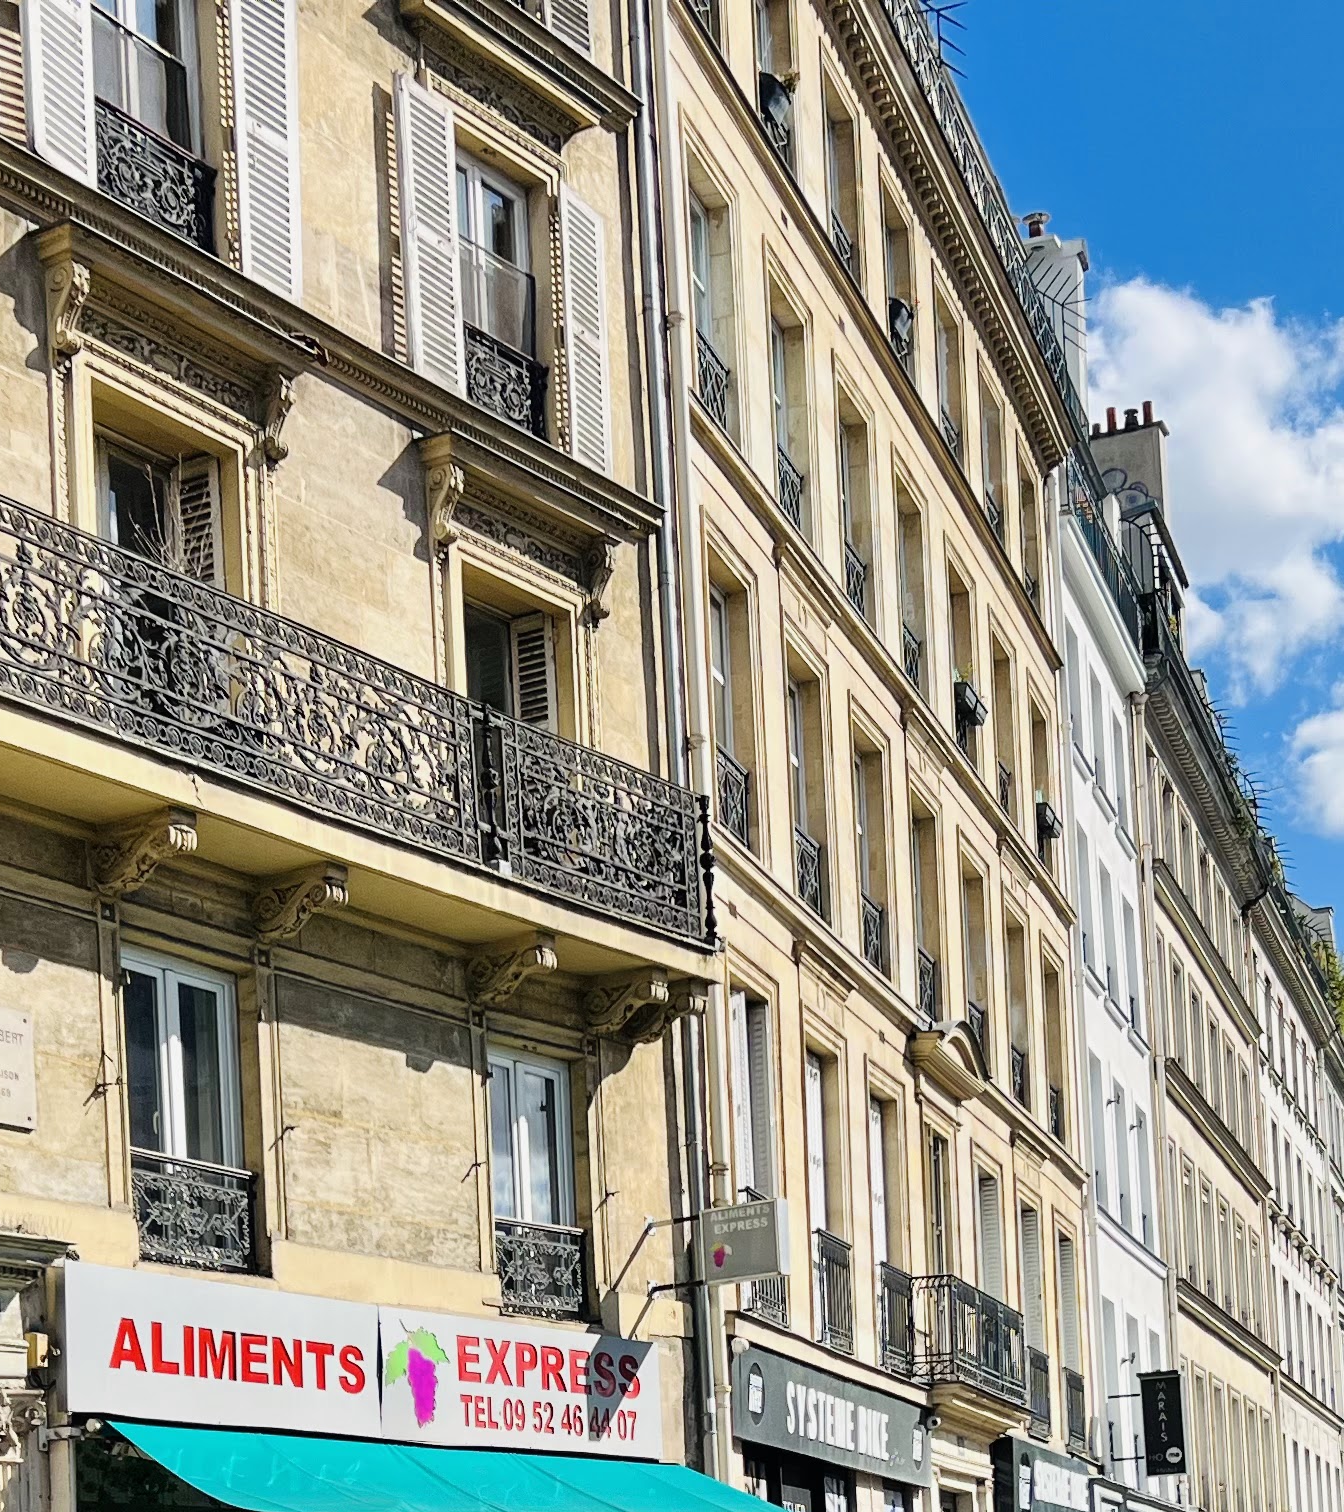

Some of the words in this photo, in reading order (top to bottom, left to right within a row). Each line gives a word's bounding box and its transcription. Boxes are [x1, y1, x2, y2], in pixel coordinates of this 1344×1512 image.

[709, 1203, 771, 1222] ALIMENTS
[713, 1216, 768, 1235] EXPRESS
[108, 1316, 366, 1395] ALIMENTS
[456, 1334, 641, 1400] EXPRESS
[532, 1400, 555, 1435] 52
[560, 1403, 584, 1437] 46
[589, 1406, 612, 1439] 44
[616, 1409, 637, 1441] 07
[1155, 1381, 1168, 1443] MARAIS
